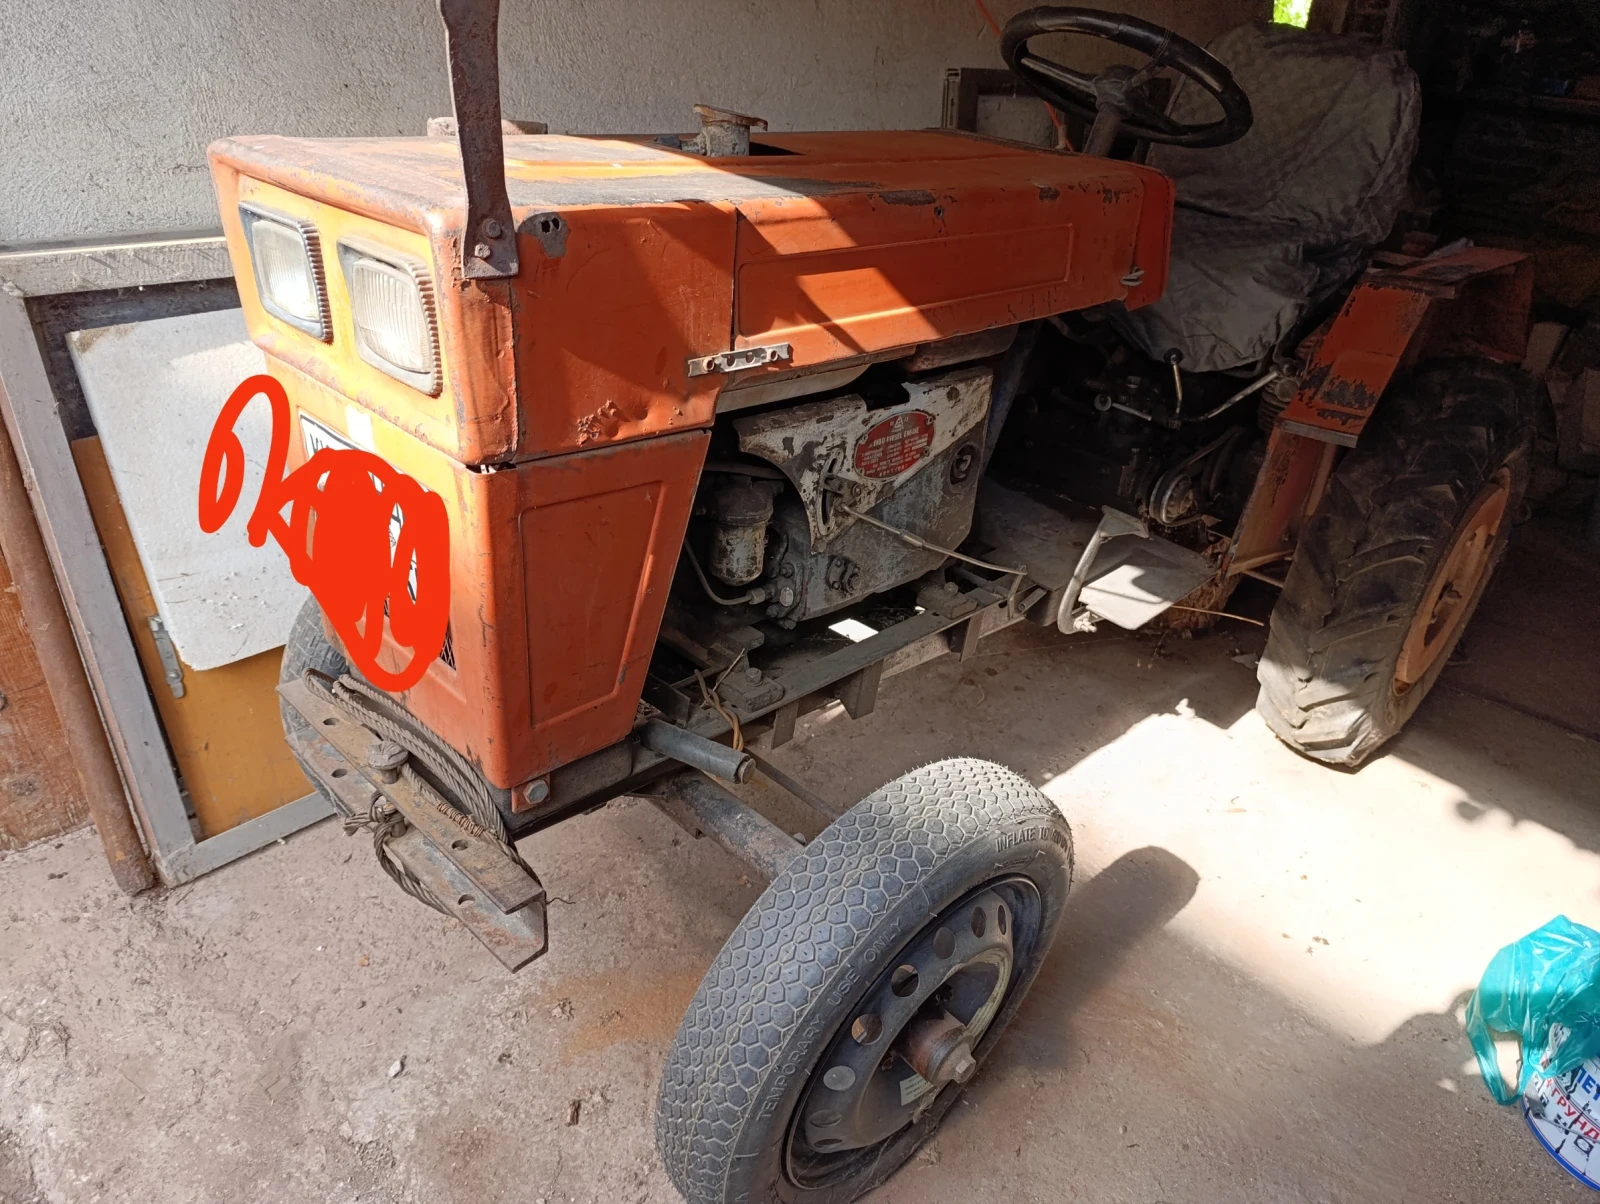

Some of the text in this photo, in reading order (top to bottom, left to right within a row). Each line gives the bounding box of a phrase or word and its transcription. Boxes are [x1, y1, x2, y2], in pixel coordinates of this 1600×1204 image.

[996, 827, 1036, 852] INFLATE
[1039, 826, 1049, 840] TO
[756, 917, 902, 1122] TEMPORARY USE ONLY
[1551, 1087, 1600, 1144] ГРУНД
